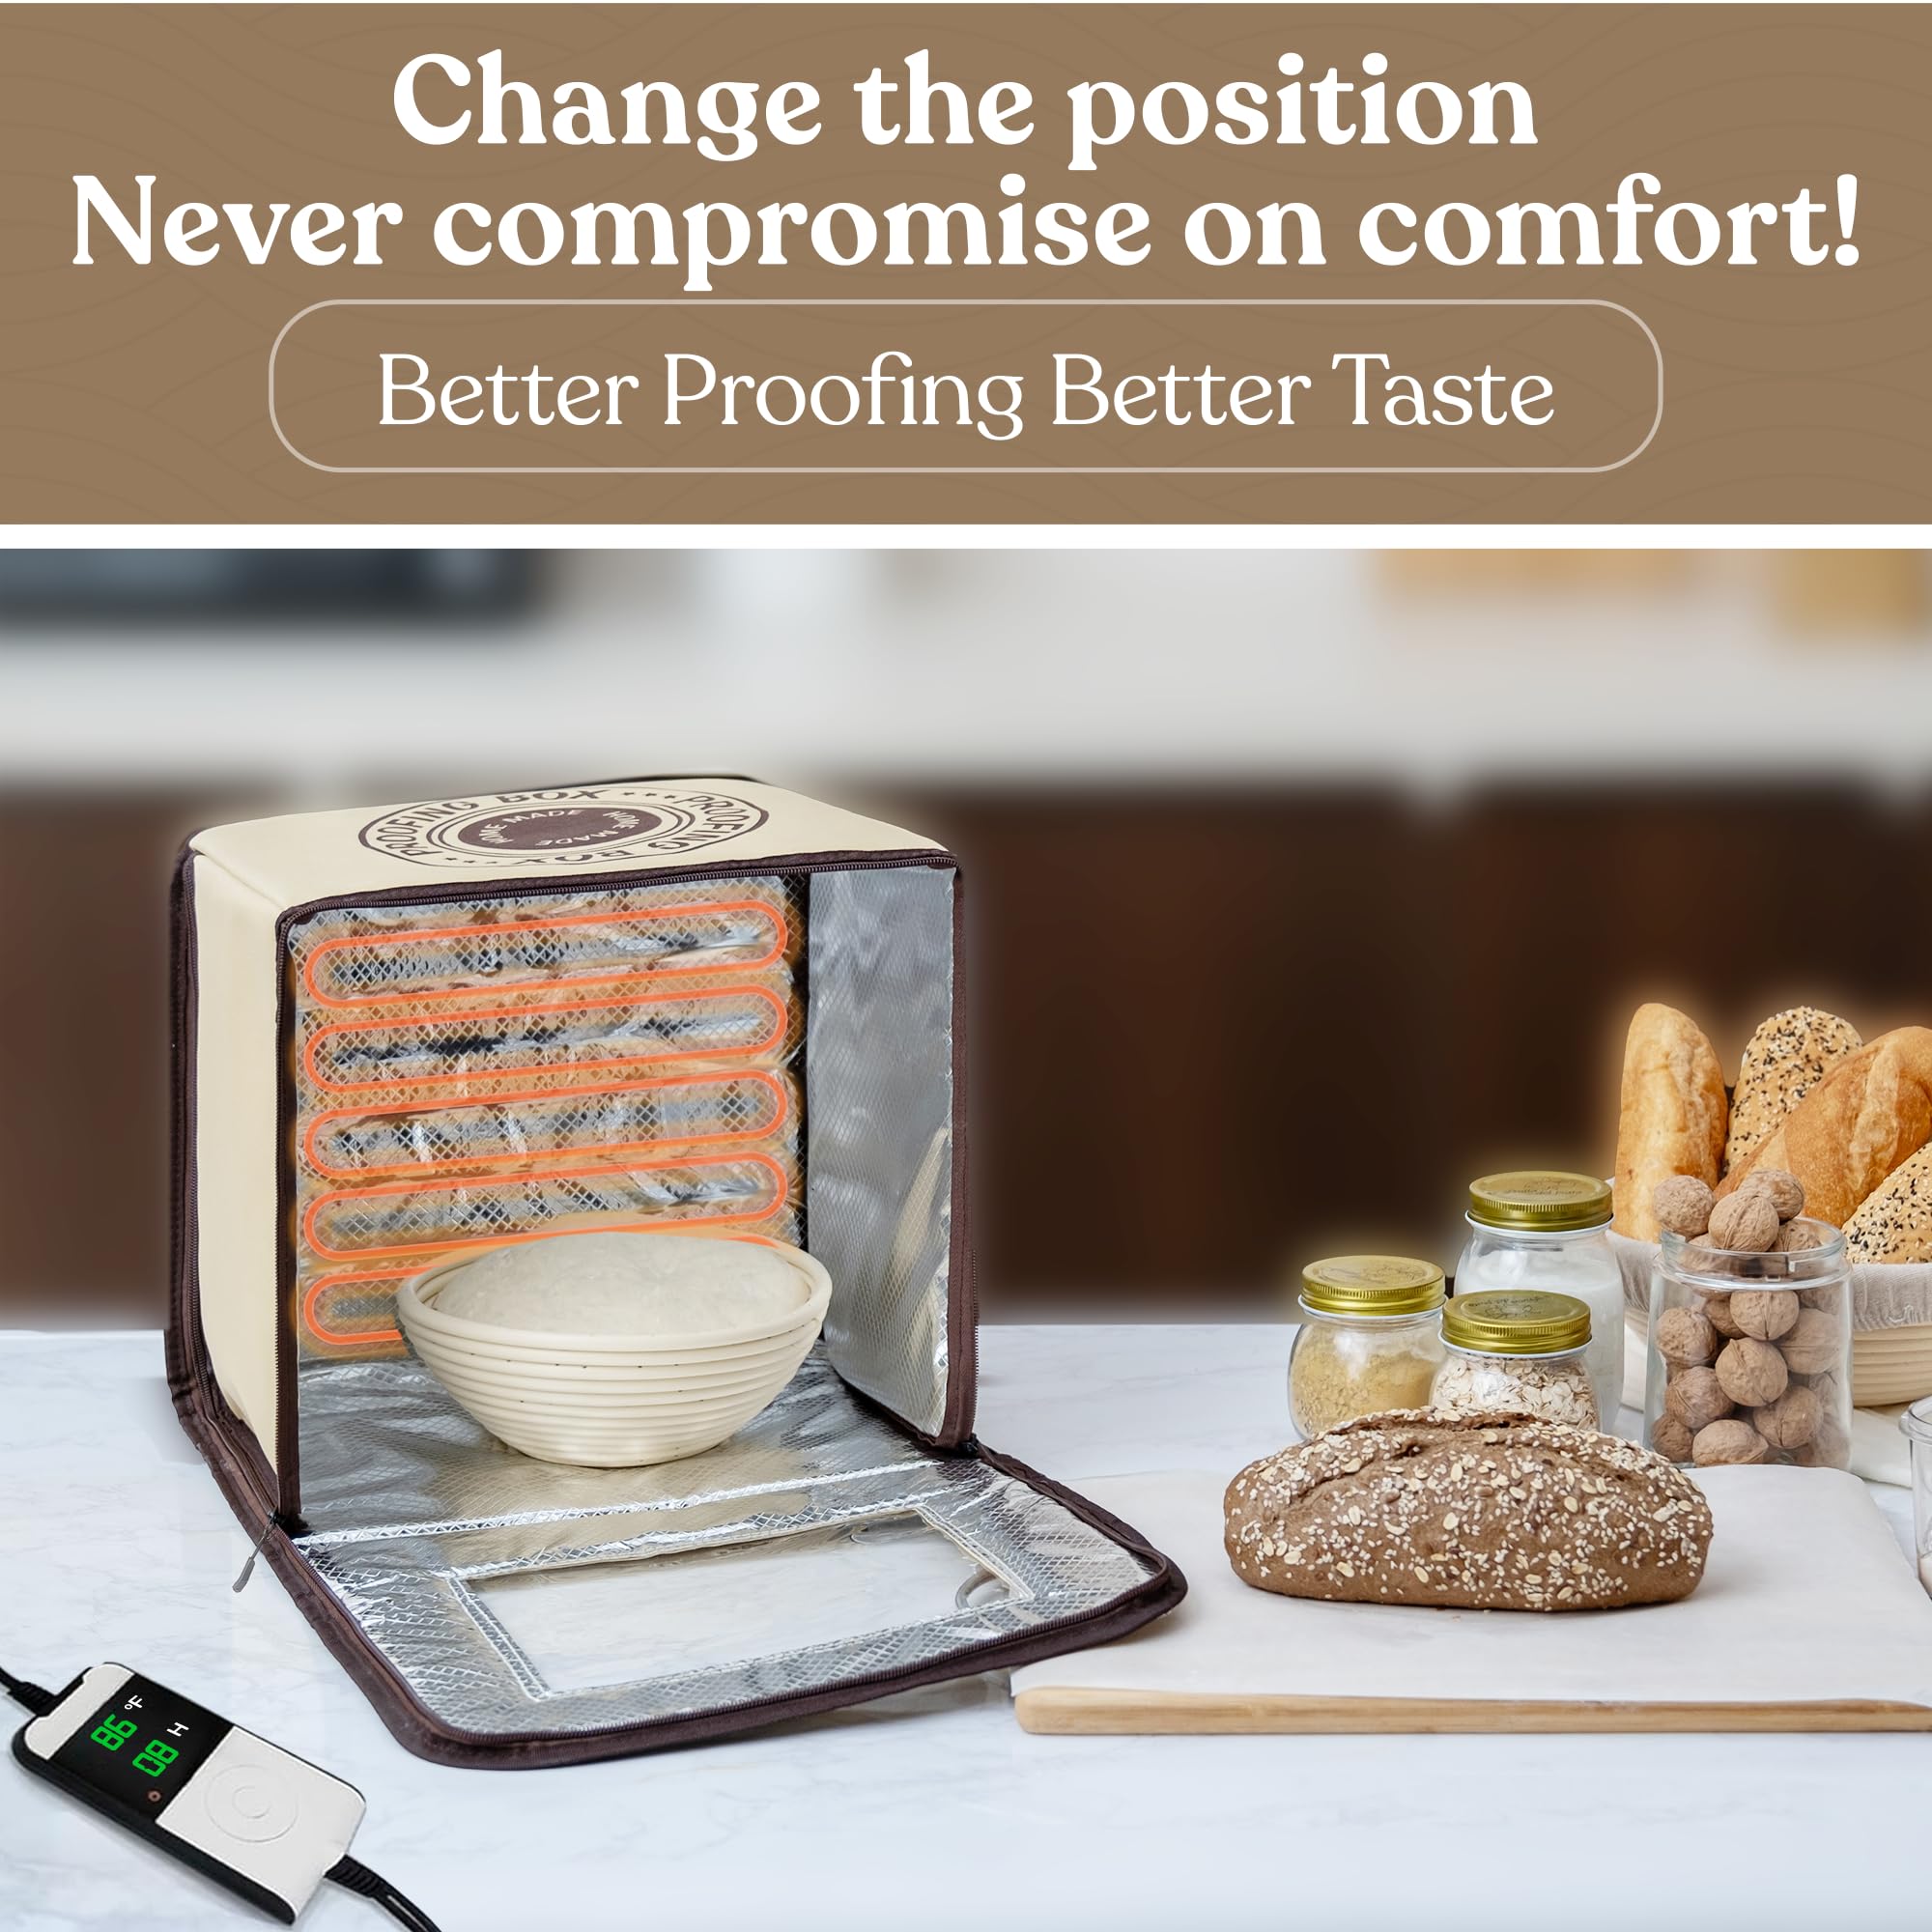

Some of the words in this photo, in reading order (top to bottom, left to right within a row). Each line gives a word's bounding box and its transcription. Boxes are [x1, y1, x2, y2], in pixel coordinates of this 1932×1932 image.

[376, 801, 480, 857] PROOFING
[496, 789, 610, 804] BOX
[478, 823, 515, 844] HOME
[501, 809, 584, 825] MADE
[602, 810, 640, 830] HOME
[647, 795, 751, 850] PROOFING
[511, 850, 635, 866] BOX
[90, 1714, 138, 1751] 86
[131, 1739, 180, 1777] 08
[166, 1721, 189, 1737] H
